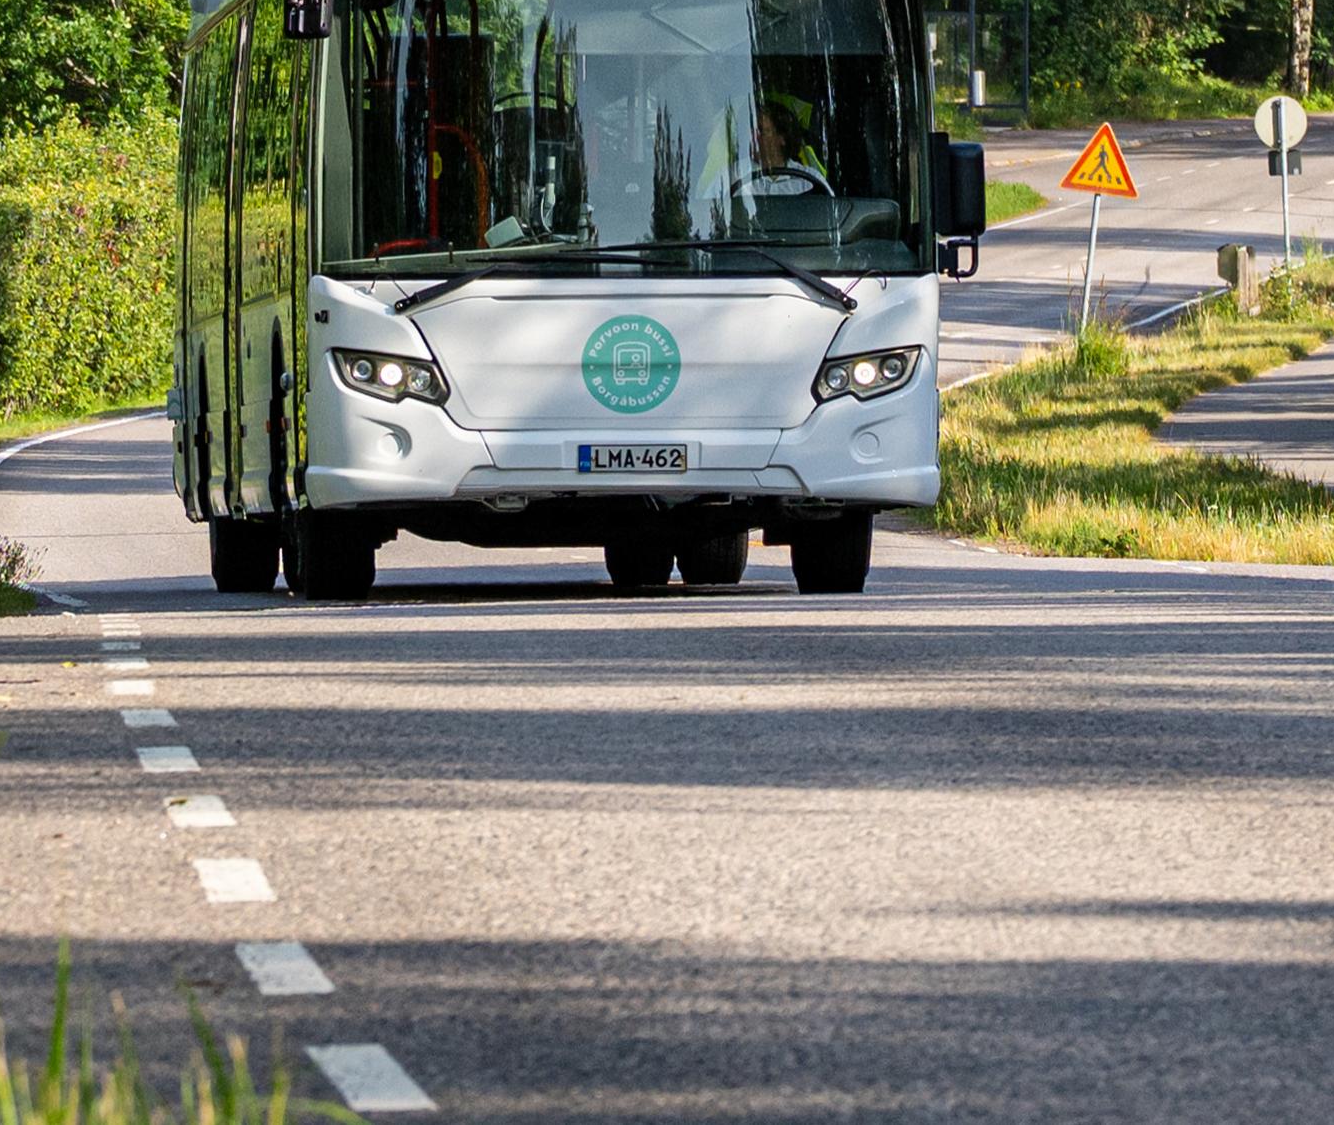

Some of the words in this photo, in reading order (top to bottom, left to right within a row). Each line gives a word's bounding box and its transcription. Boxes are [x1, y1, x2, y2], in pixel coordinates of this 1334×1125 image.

[589, 323, 639, 357] Porvoon
[644, 324, 674, 356] bussi
[593, 377, 670, 406] Borgåbussen
[594, 448, 682, 468] LMA-462
